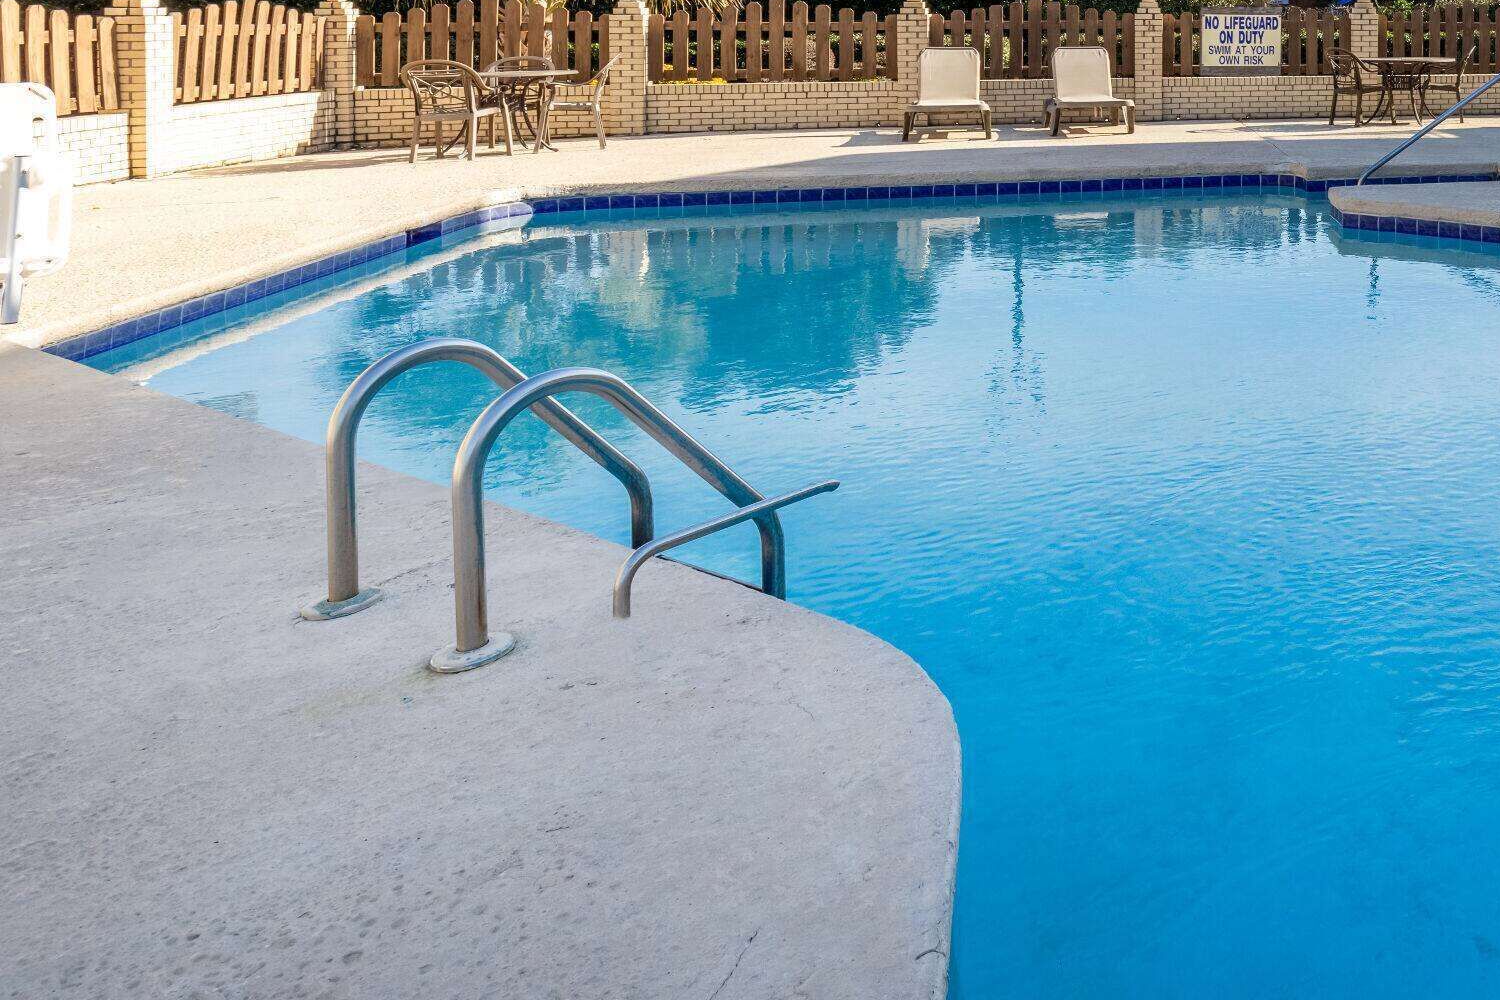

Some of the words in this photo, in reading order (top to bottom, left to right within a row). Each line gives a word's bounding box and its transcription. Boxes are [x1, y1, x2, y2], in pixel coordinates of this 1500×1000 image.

[1204, 16, 1219, 29] NO
[1224, 16, 1279, 30] LIFEGUARD
[1219, 30, 1234, 44] ON
[1239, 30, 1264, 44] DUTY
[1208, 46, 1231, 55] SWIM
[1235, 46, 1246, 54] AT
[1250, 46, 1275, 55] YOUR
[1219, 55, 1240, 65] OWN
[1244, 55, 1264, 65] RISK
